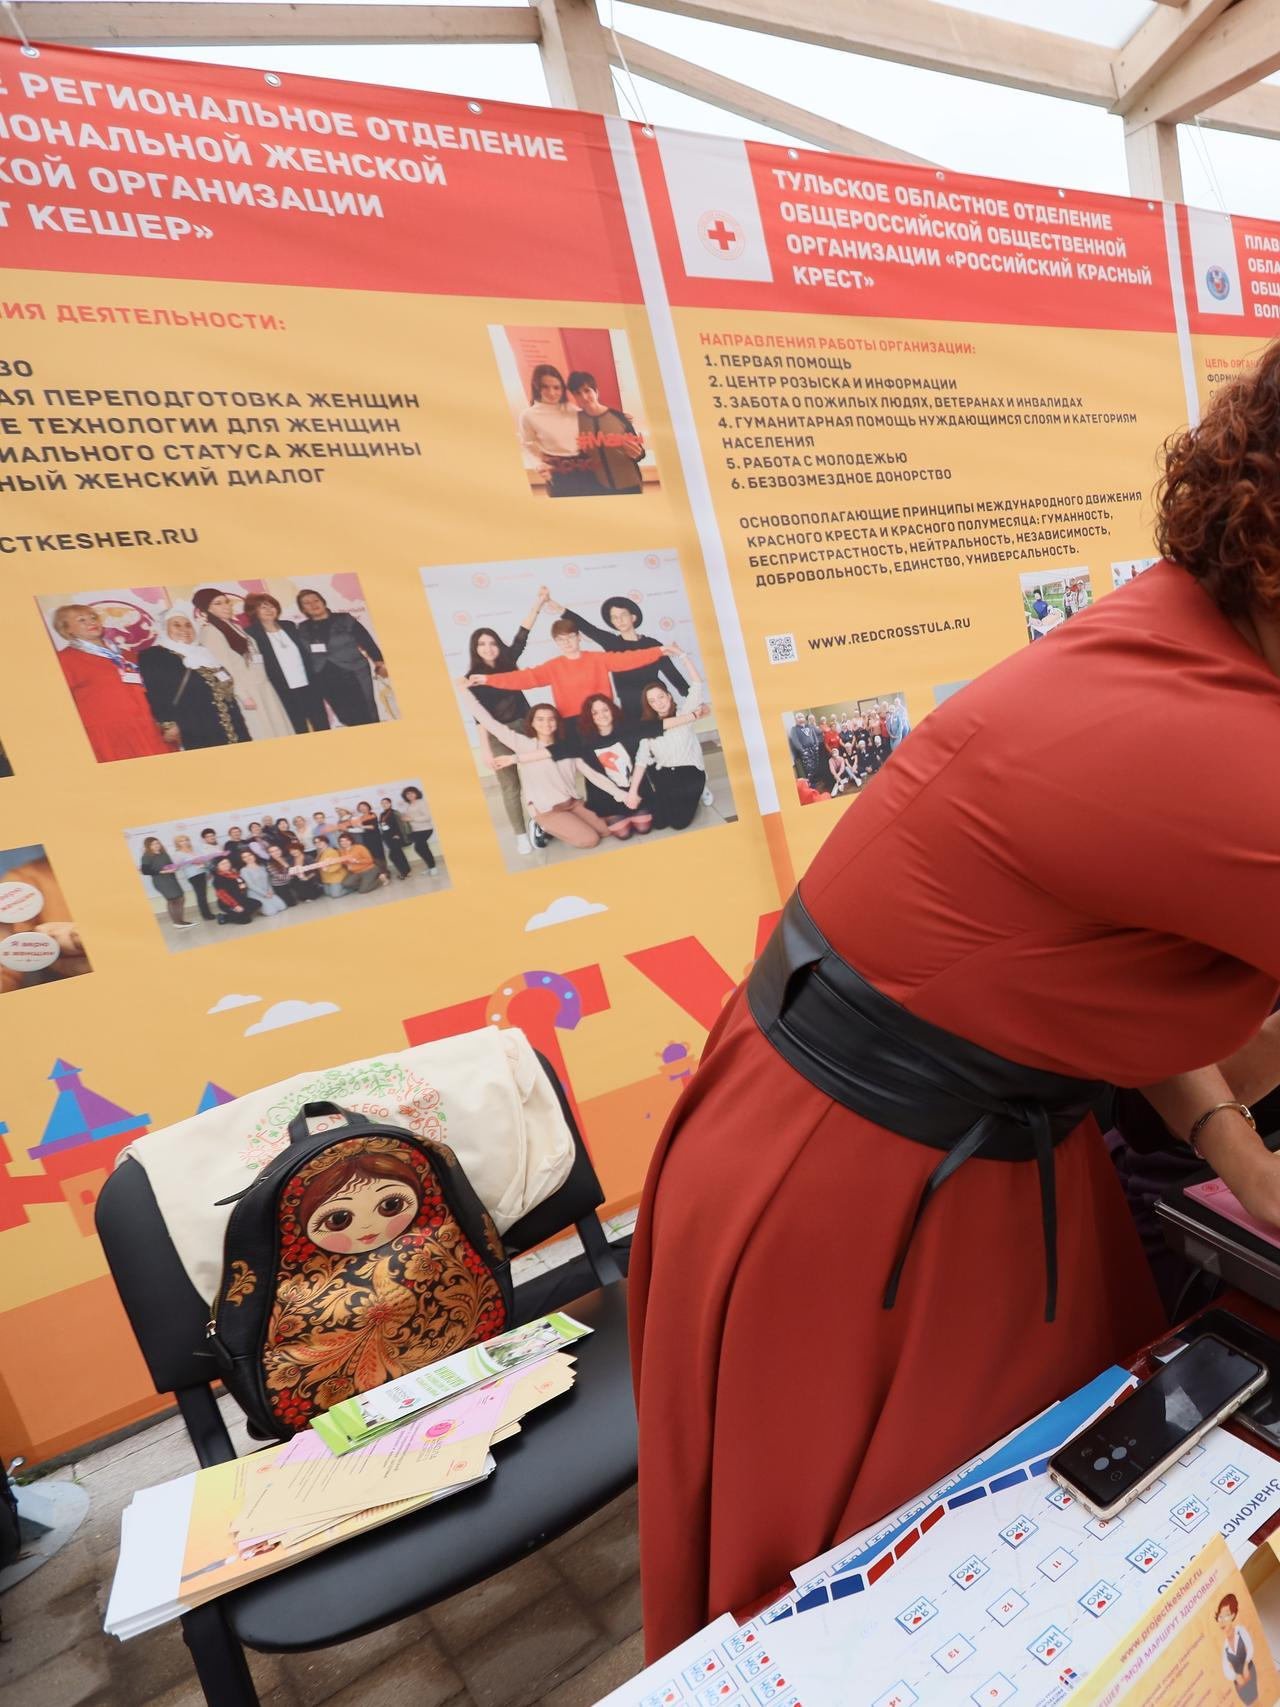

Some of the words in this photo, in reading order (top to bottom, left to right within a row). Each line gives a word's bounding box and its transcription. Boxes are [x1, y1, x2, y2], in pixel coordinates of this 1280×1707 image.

[19, 71, 358, 137] РЕГИОНАЛЬНОЕ
[365, 116, 567, 161] ОТДЕЛЕНИЕ
[260, 143, 447, 186] ЖЕНСКОЙ
[88, 166, 384, 218] ОРГАНИЗАЦИИ
[771, 168, 890, 203] ТУЛЬСКОЕ
[894, 185, 1009, 218] ОБЛАСТНОЕ
[1013, 202, 1113, 231] ОТДЕЛЕНИЕ
[27, 203, 213, 240] КЕШЕР»
[779, 201, 983, 242] ОБЩЕРОССИЙСКОЙ
[986, 226, 1127, 258] ОБЩЕСТВЕННОЙ
[786, 233, 941, 266] ОРГАНИЗАЦИИ
[945, 250, 1073, 278] «РОССИЙСКИЙ
[1076, 263, 1152, 285] КРАСНЫЙ
[792, 265, 874, 289] КРЕСТ»
[56, 304, 285, 330] ДЕЯТЕЛЬНОСТИ:
[699, 332, 816, 349] НАПРАВЛЕНИЯ
[818, 337, 877, 351] РАБОТЫ
[878, 339, 976, 355] ОРГАНИЗАЦИИ:
[704, 354, 717, 367] 1.
[719, 354, 783, 368] ПЕРВАЯ
[785, 356, 852, 371] ПОМОЩЬ
[1204, 358, 1229, 369] ЦЕЛЬ
[708, 375, 723, 387] 2.
[725, 375, 776, 389] ЦЕНТР
[779, 376, 851, 389] РОЗЫСКА
[852, 377, 862, 389] И
[864, 377, 957, 391] ИНФОРМАЦИИ
[43, 389, 302, 408] ПЕРЕПОДГОТОВКА
[306, 392, 419, 410] ЖЕНЩИН
[712, 395, 727, 408] 3.
[729, 395, 790, 408] ЗАБОТА
[791, 396, 801, 408] О
[804, 396, 878, 408] ПОЖИЛЫХ
[880, 396, 932, 409] ЛЮДЯХ,
[934, 396, 1005, 408] ВЕТЕРАНАХ
[1006, 397, 1015, 407] И
[1016, 397, 1083, 408] ИНВАЛИДАХ
[27, 417, 218, 434] ТЕХНОЛОГИИ
[227, 417, 280, 435] ДЛЯ
[286, 417, 400, 434] ЖЕНЩИН
[717, 416, 733, 429] 4.
[734, 415, 854, 428] ГУМАНИТАРНАЯ
[855, 415, 916, 427] ПОМОЩЬ
[918, 414, 1022, 427] НУЖДАЮЩИМСЯ
[1023, 413, 1062, 424] СЛОЯМ
[1062, 414, 1071, 424] И
[1071, 413, 1137, 424] КАТЕГОРИЯМ
[163, 443, 281, 460] СТАТУСА
[285, 442, 421, 458] ЖЕНЩИНЫ
[722, 435, 814, 449] НАСЕЛЕНИЯ
[726, 457, 740, 470] 5.
[742, 455, 801, 469] РАБОТА
[803, 455, 813, 467] С
[815, 451, 907, 466] МОЛОДЕЖЬЮ
[74, 466, 218, 490] ЖЕНСКИЙ
[227, 468, 325, 487] ДИАЛОГ
[731, 477, 745, 490] 6.
[747, 471, 873, 489] БЕЗВОЗМЕЗДНОЕ
[876, 468, 952, 484] ДОНОРСТВО
[739, 507, 900, 529] ОСНОВОПОЛАГАЮЩИЕ
[902, 502, 974, 518] ПРИНЦИПЫ
[976, 495, 1083, 512] МЕЖДУНАРОДНОГО
[1085, 491, 1142, 505] ДВИЖЕНИЯ
[746, 531, 822, 548] КРАСНОГО
[824, 527, 878, 542] КРЕСТА
[879, 526, 889, 537] И
[890, 521, 955, 537] КРАСНОГО
[957, 515, 1040, 531] ПОЛУМЕСЯЦА:
[1041, 509, 1113, 524] ГУМАННОСТЬ,
[748, 543, 907, 568] БЕСПРИСТРАСТНОСТЬ,
[909, 534, 1014, 553] НЕЙТРАЛЬНОСТЬ,
[1015, 525, 1110, 543] НЕЗАВИСИМОСТЬ,
[756, 563, 892, 588] ДОБРОВОЛЬНОСТЬ,
[893, 555, 964, 573] ЕДИНСТВО,
[965, 544, 1079, 565] УНИВЕРСАЛЬНОСТЬ.
[807, 617, 970, 650] WWW.REDCROSSTULA.RU
